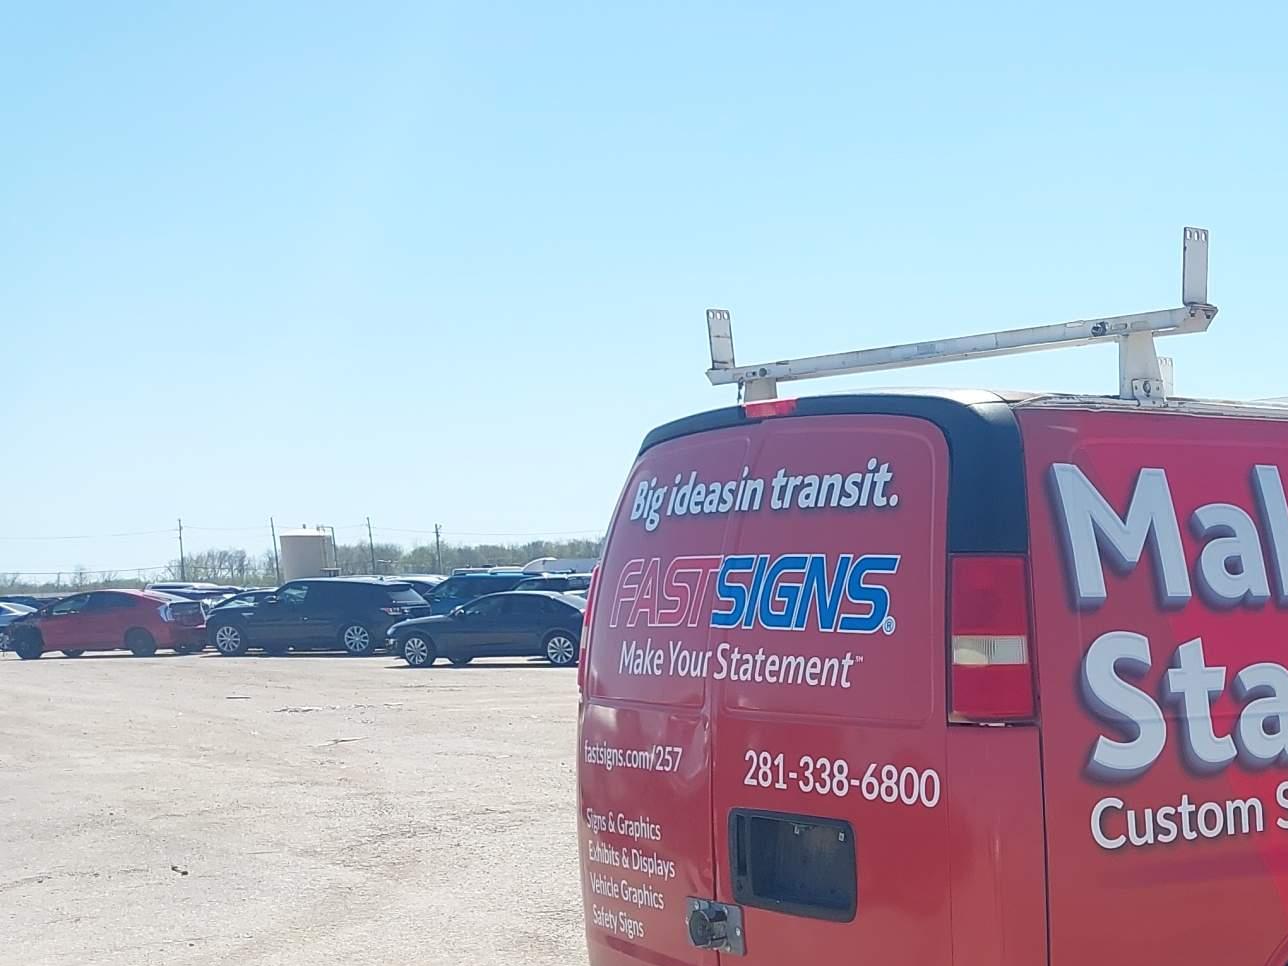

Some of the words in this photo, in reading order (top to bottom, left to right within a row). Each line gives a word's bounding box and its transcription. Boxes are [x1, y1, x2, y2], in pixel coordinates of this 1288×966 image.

[630, 477, 668, 531] Big
[771, 458, 899, 509] transit.
[619, 638, 663, 676] Make
[668, 640, 712, 679] Your
[714, 643, 854, 688] Statement
[584, 740, 683, 772] fastsigns.com/257
[743, 749, 941, 808] 281-338-6800
[586, 808, 607, 834] Signs
[608, 812, 616, 833] &
[617, 813, 661, 842] Graphics
[1090, 795, 1264, 850] Custom
[588, 840, 620, 868] Exhibits
[621, 850, 630, 869] &
[631, 849, 676, 880] Displays
[590, 871, 619, 898] Vehicle
[620, 879, 664, 910] Graphics
[592, 903, 618, 934] Safety
[618, 911, 644, 939] Signs
